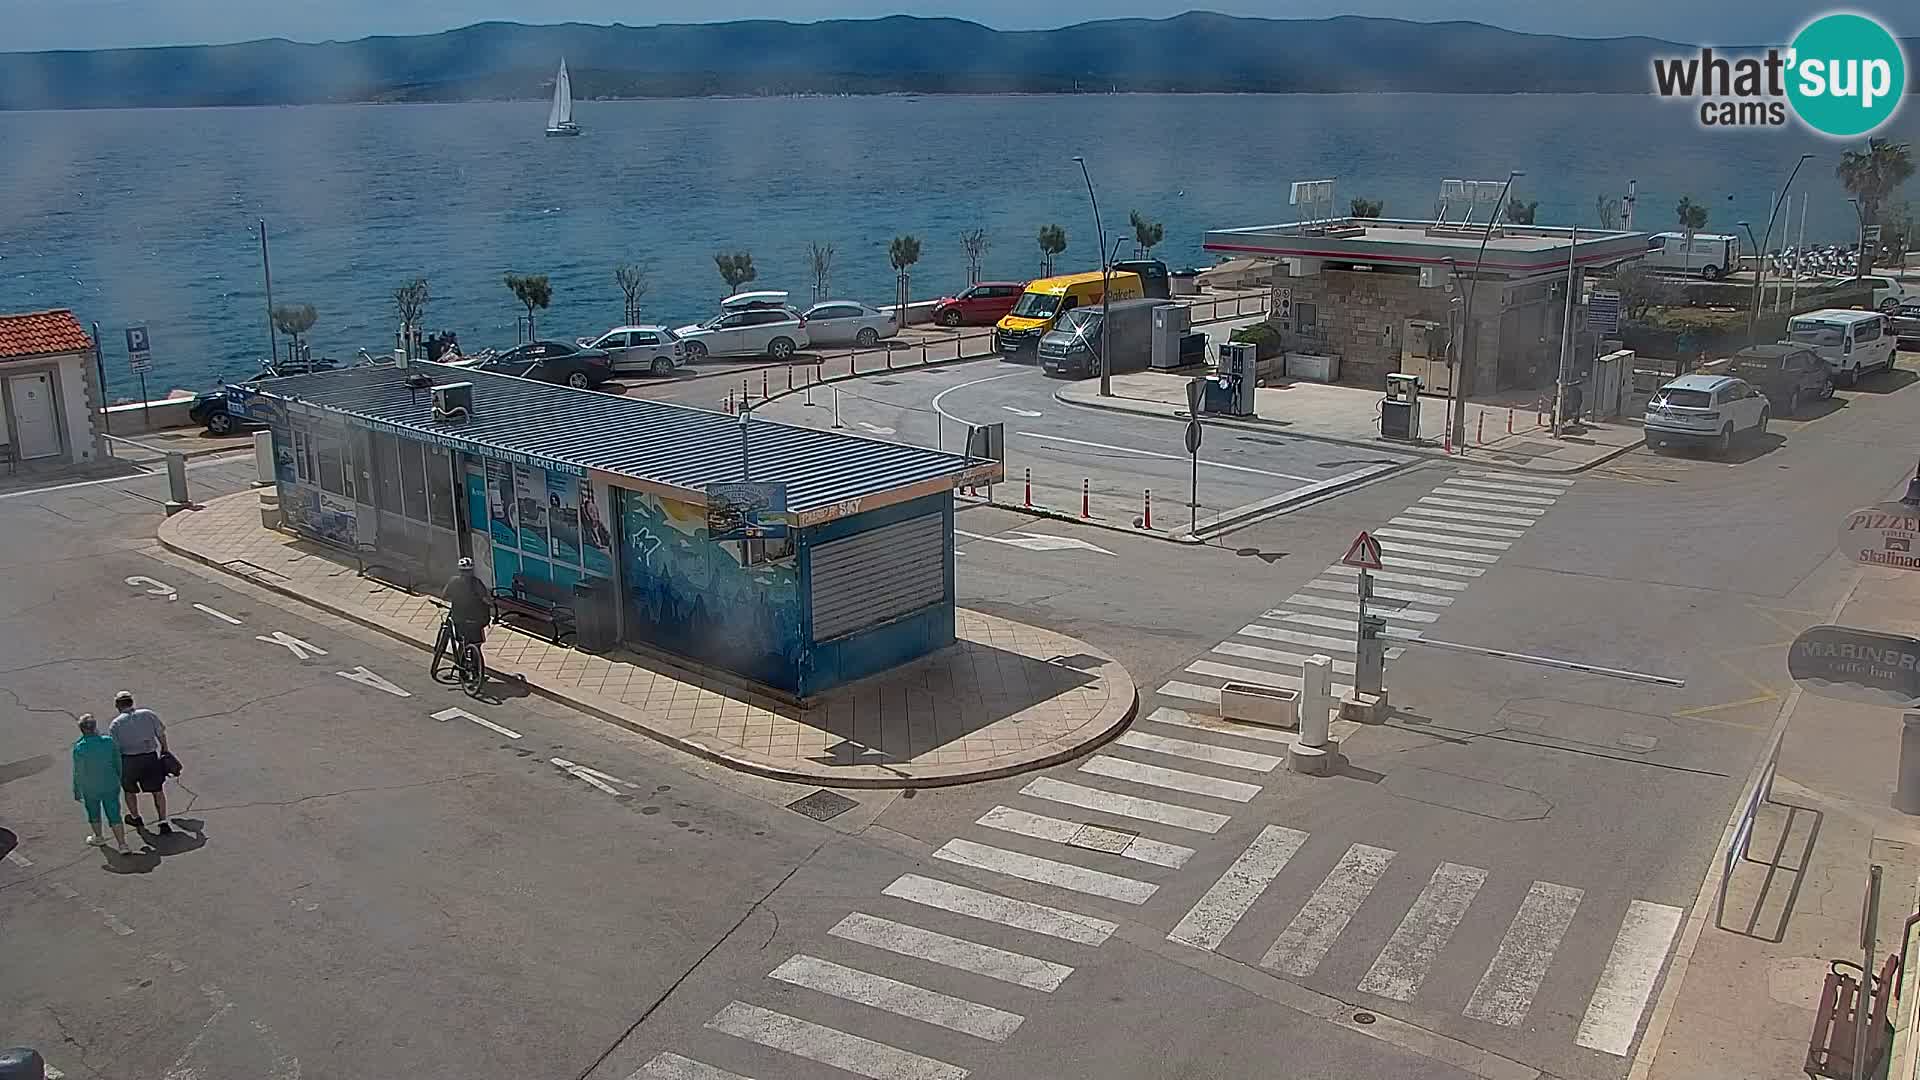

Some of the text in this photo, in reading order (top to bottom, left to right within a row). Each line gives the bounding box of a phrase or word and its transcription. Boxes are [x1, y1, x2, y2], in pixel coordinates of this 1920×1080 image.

[131, 330, 144, 349] P
[437, 436, 468, 451] POSTAJA
[479, 445, 494, 457] BUS
[494, 449, 527, 465] STATION
[528, 456, 555, 471] TICKET
[556, 462, 583, 477] OFFICE
[1848, 515, 1920, 532] PIZZE
[1800, 642, 1920, 672] MARINER
